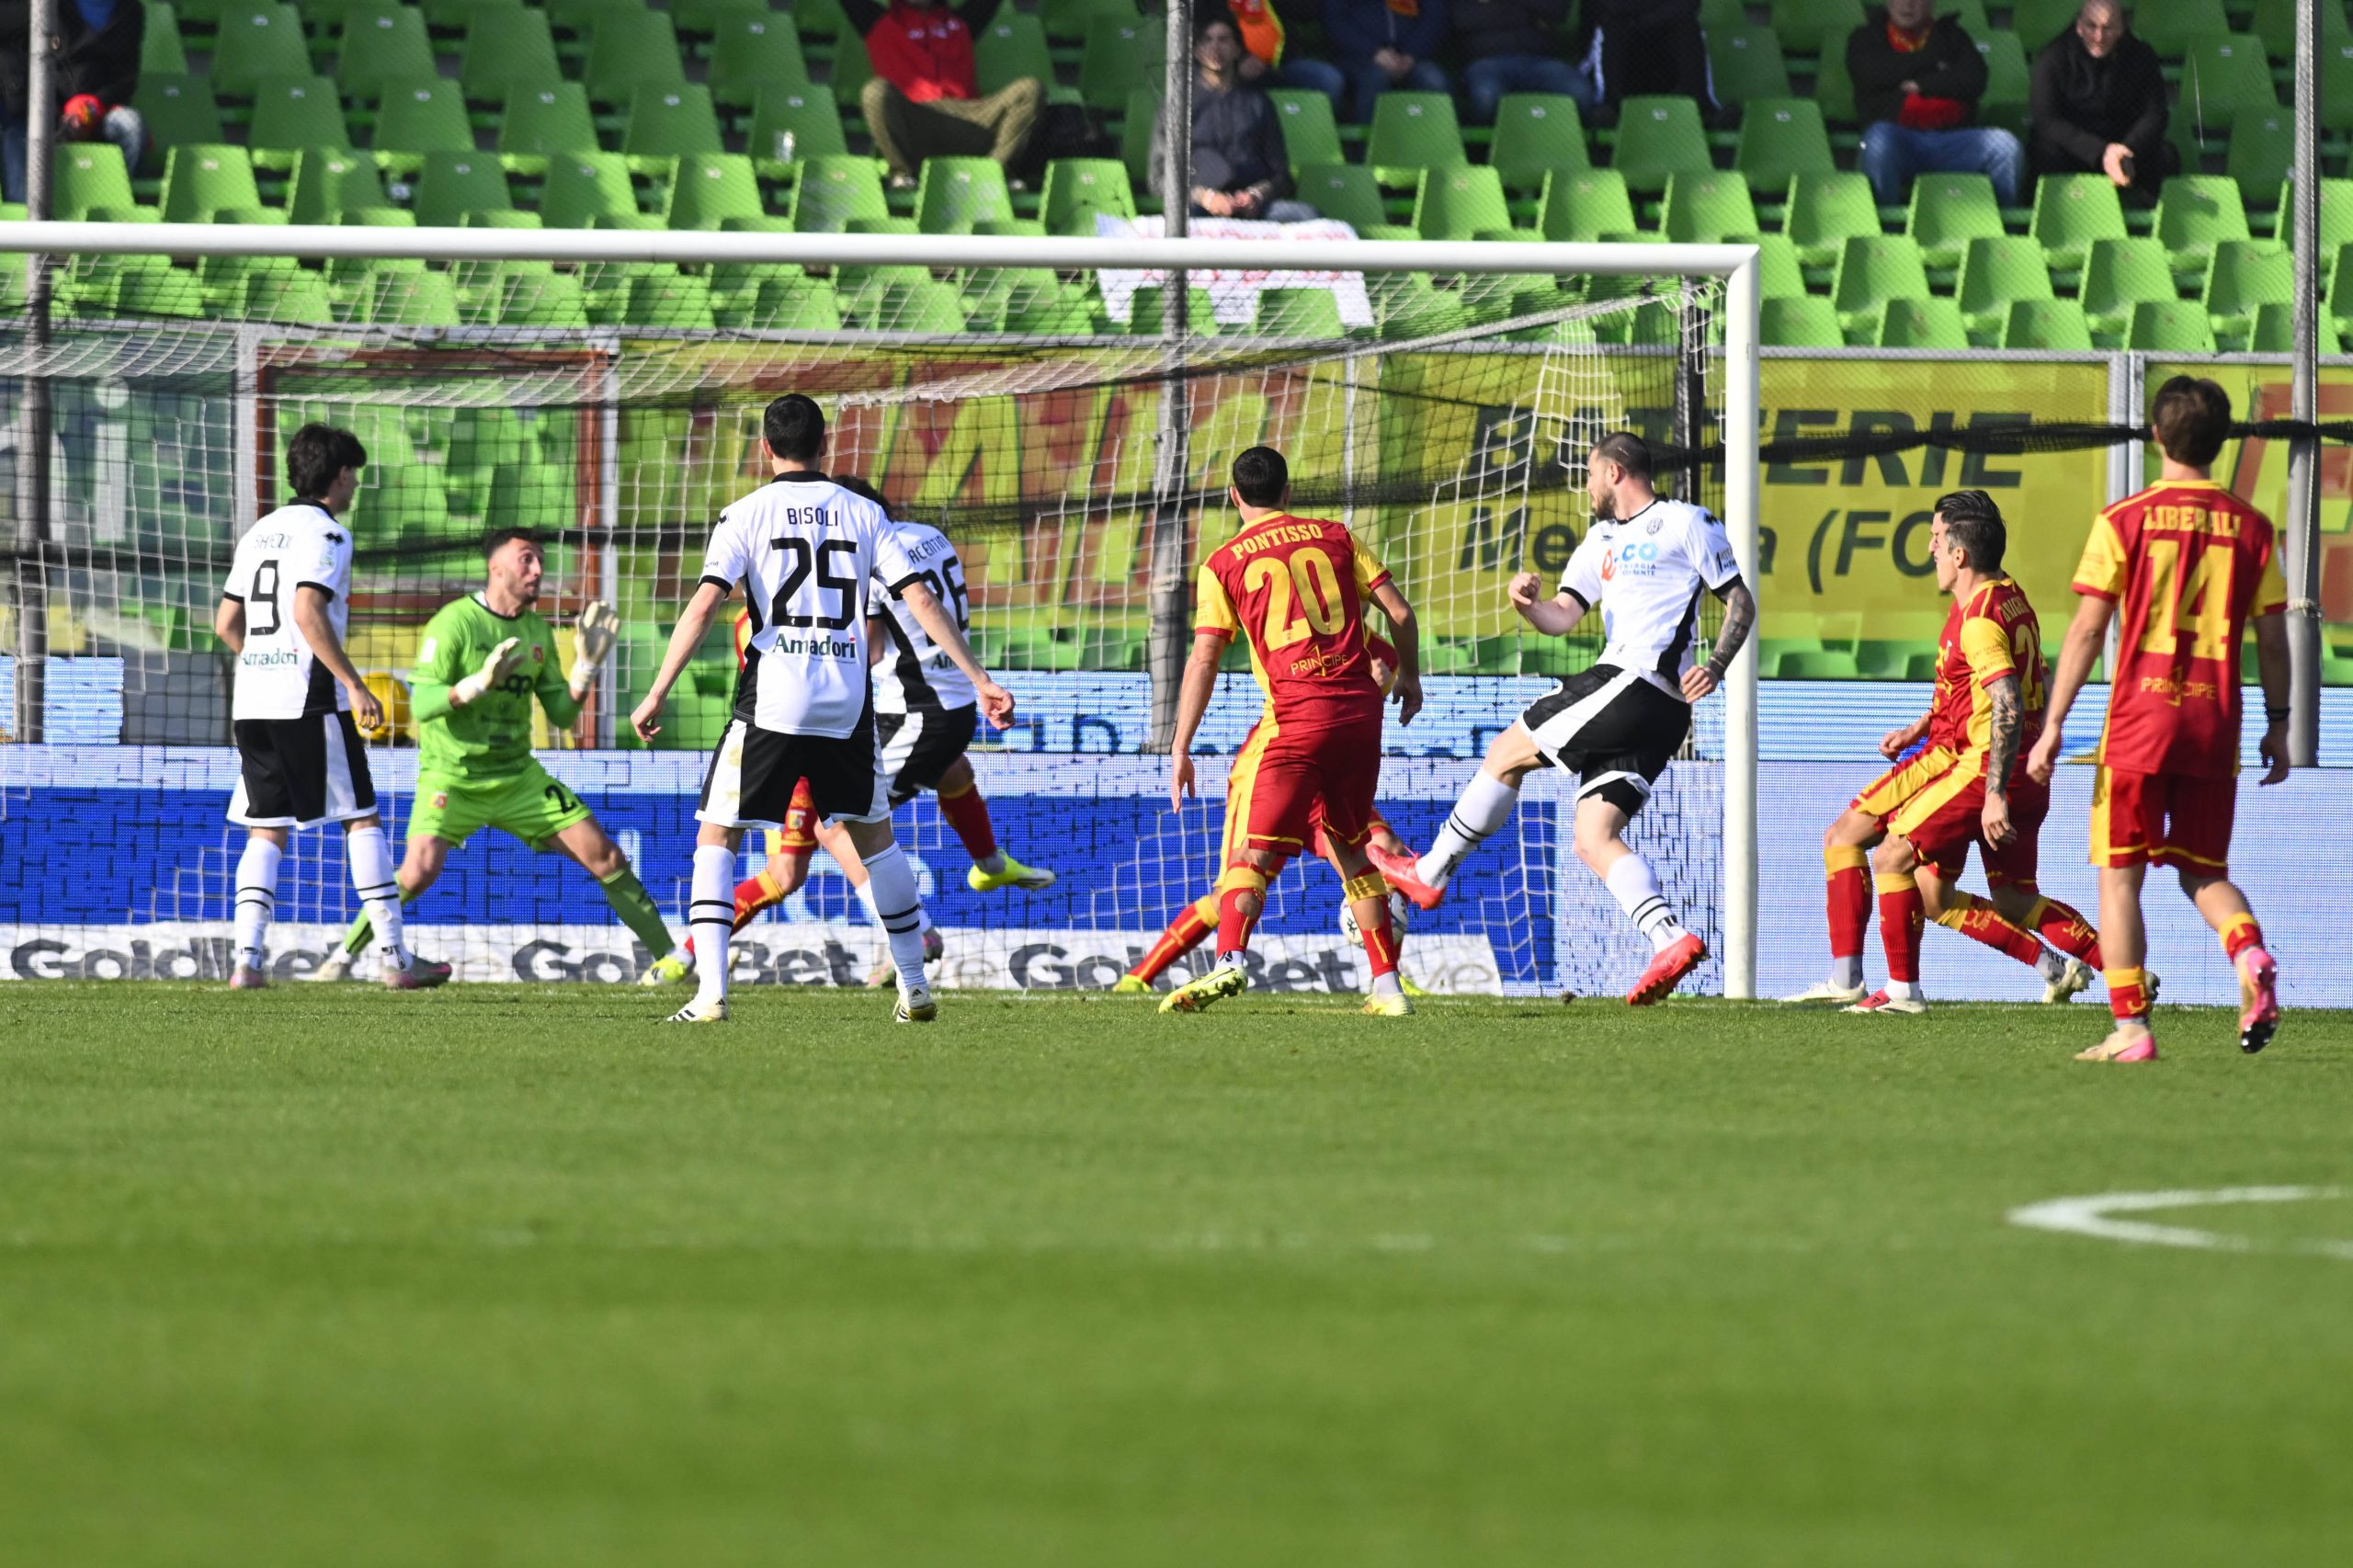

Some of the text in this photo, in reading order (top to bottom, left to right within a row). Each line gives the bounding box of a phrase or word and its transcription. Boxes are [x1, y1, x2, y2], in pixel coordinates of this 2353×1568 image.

[787, 506, 838, 527] BISOLI
[2143, 506, 2241, 539] LIBERALI
[907, 535, 950, 564] ACENTIN
[1230, 523, 1324, 561] PONTISSO
[1807, 509, 1941, 595] (FO
[250, 559, 281, 636] 9
[770, 537, 858, 631] 25
[1244, 546, 1346, 652] 20
[2138, 540, 2234, 662] 14
[772, 633, 856, 659] Amadori
[1290, 647, 1349, 677] PRINCIPE
[2140, 669, 2217, 704] PRINCIPE
[512, 939, 870, 985] GolBet
